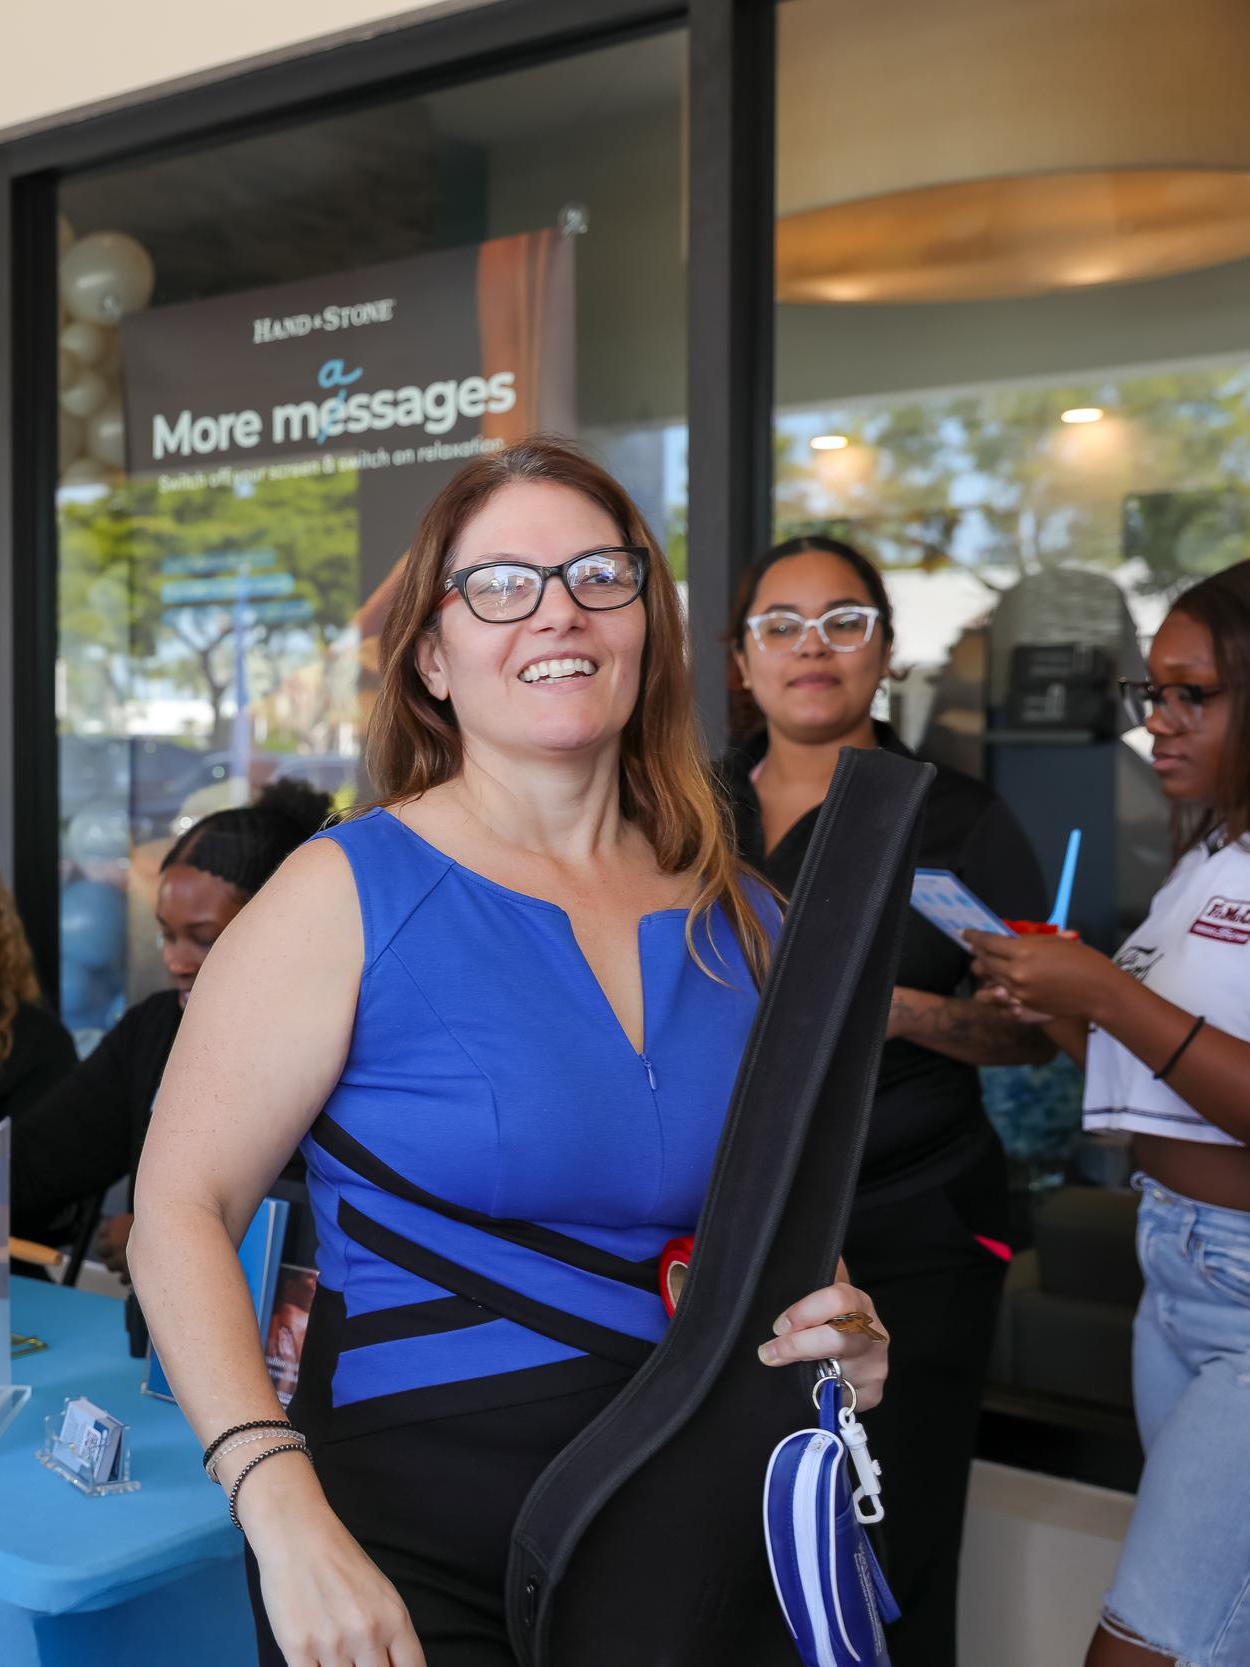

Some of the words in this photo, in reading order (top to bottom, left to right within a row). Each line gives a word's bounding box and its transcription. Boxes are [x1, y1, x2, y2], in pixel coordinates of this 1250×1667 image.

[252, 315, 312, 344] HAND
[322, 298, 396, 332] STONE
[317, 358, 364, 389] a
[152, 409, 263, 460] More
[272, 371, 517, 445] messages
[391, 447, 416, 466] on
